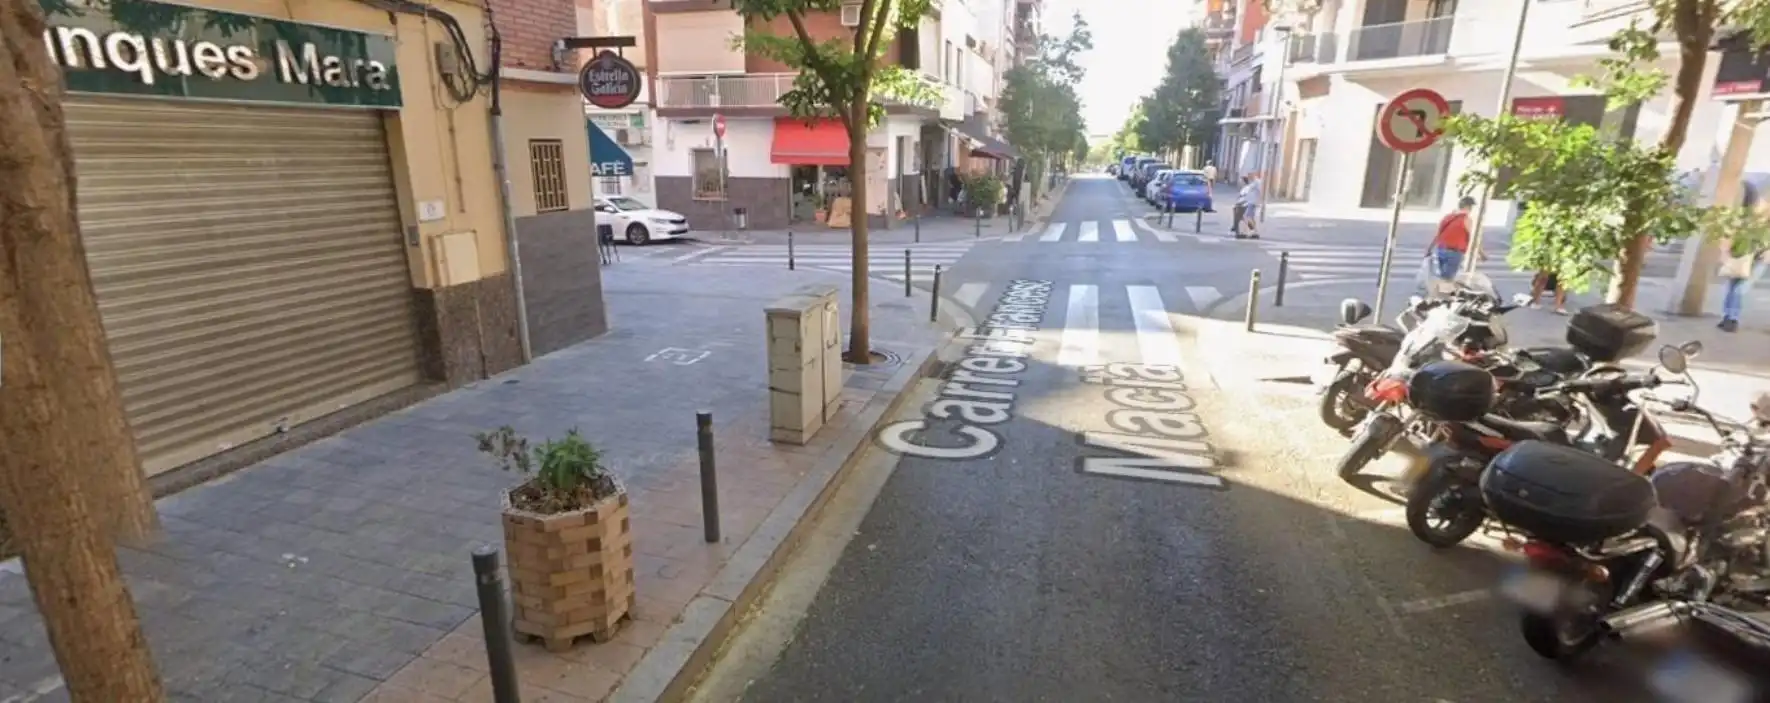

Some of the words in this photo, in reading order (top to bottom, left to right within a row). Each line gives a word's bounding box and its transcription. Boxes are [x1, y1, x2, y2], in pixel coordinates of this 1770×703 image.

[44, 26, 259, 86] inques
[275, 39, 391, 91] Mara
[589, 69, 629, 82] Estrella
[591, 159, 626, 175] AFÈ
